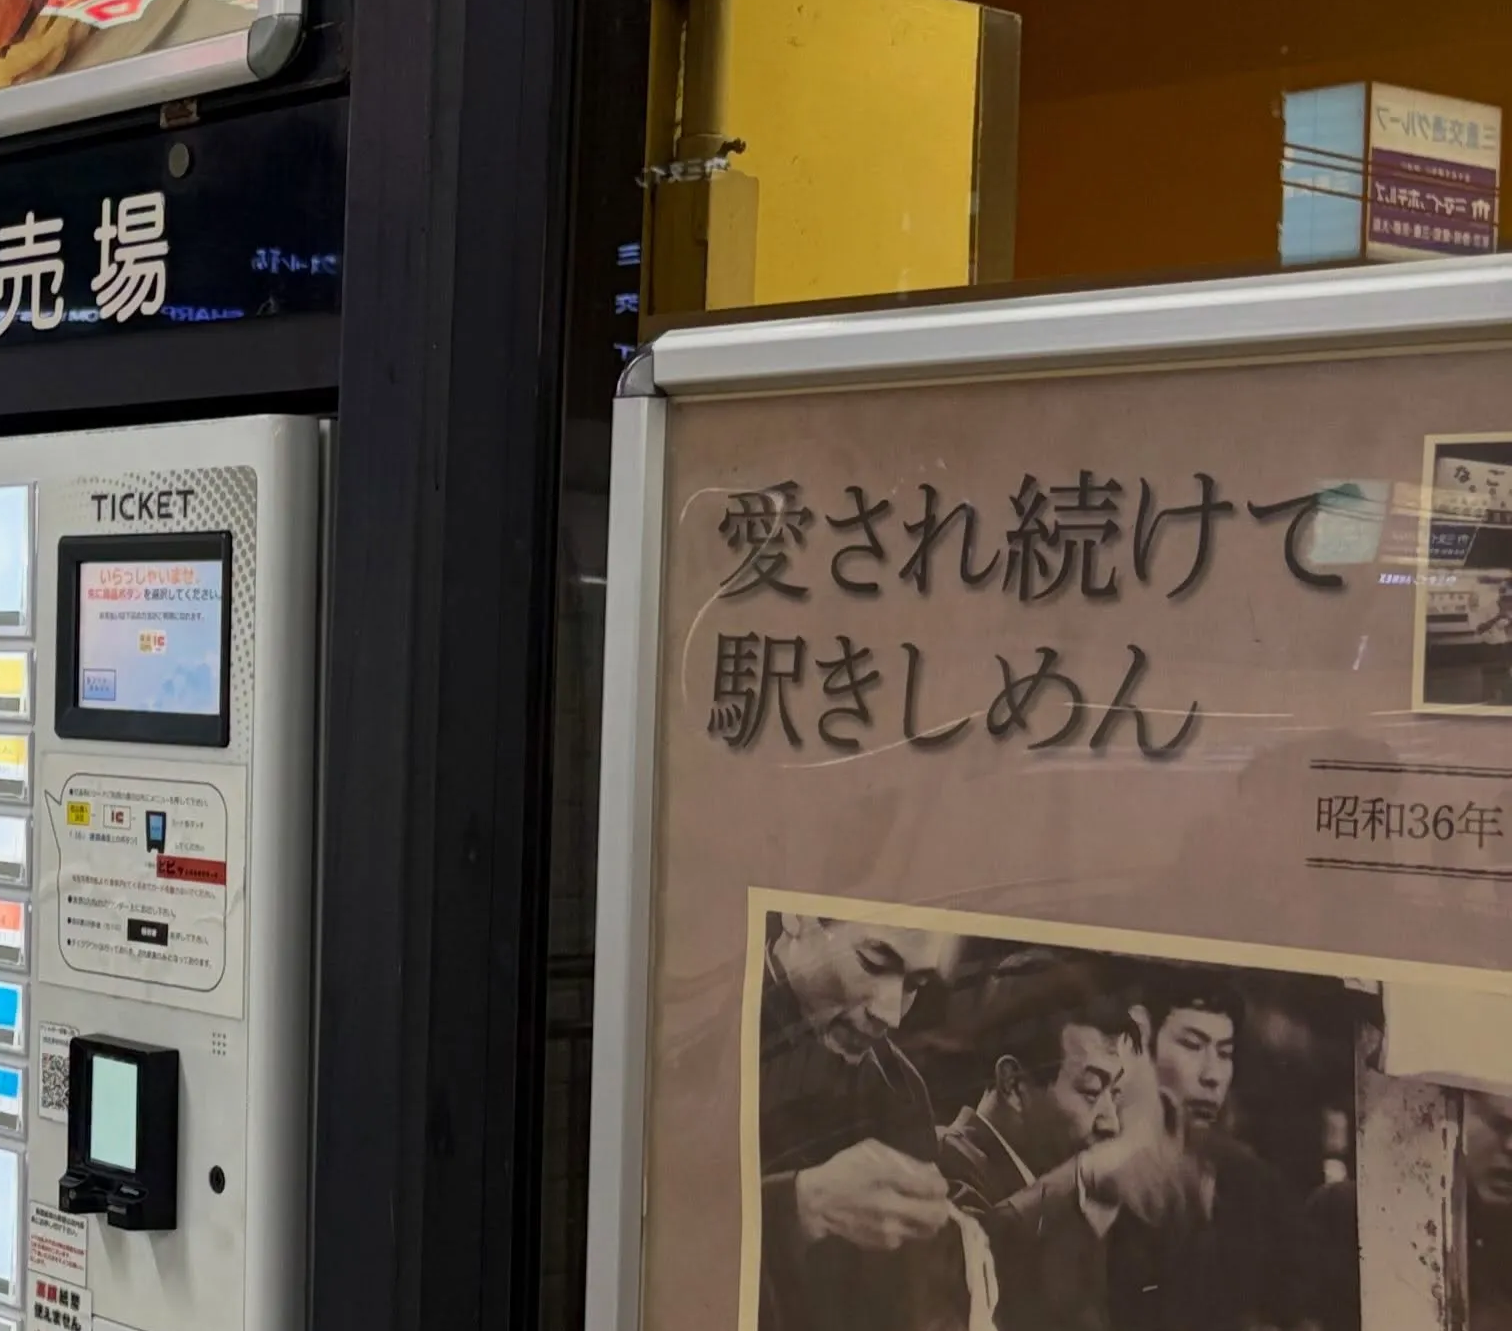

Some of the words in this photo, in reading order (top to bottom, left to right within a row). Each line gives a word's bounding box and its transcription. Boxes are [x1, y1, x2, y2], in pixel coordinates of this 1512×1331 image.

[90, 489, 194, 521] TICKET
[716, 470, 1348, 601] 愛され続けて
[706, 630, 1199, 760] 駅きしめん
[1316, 795, 1504, 850] 昭和36年
